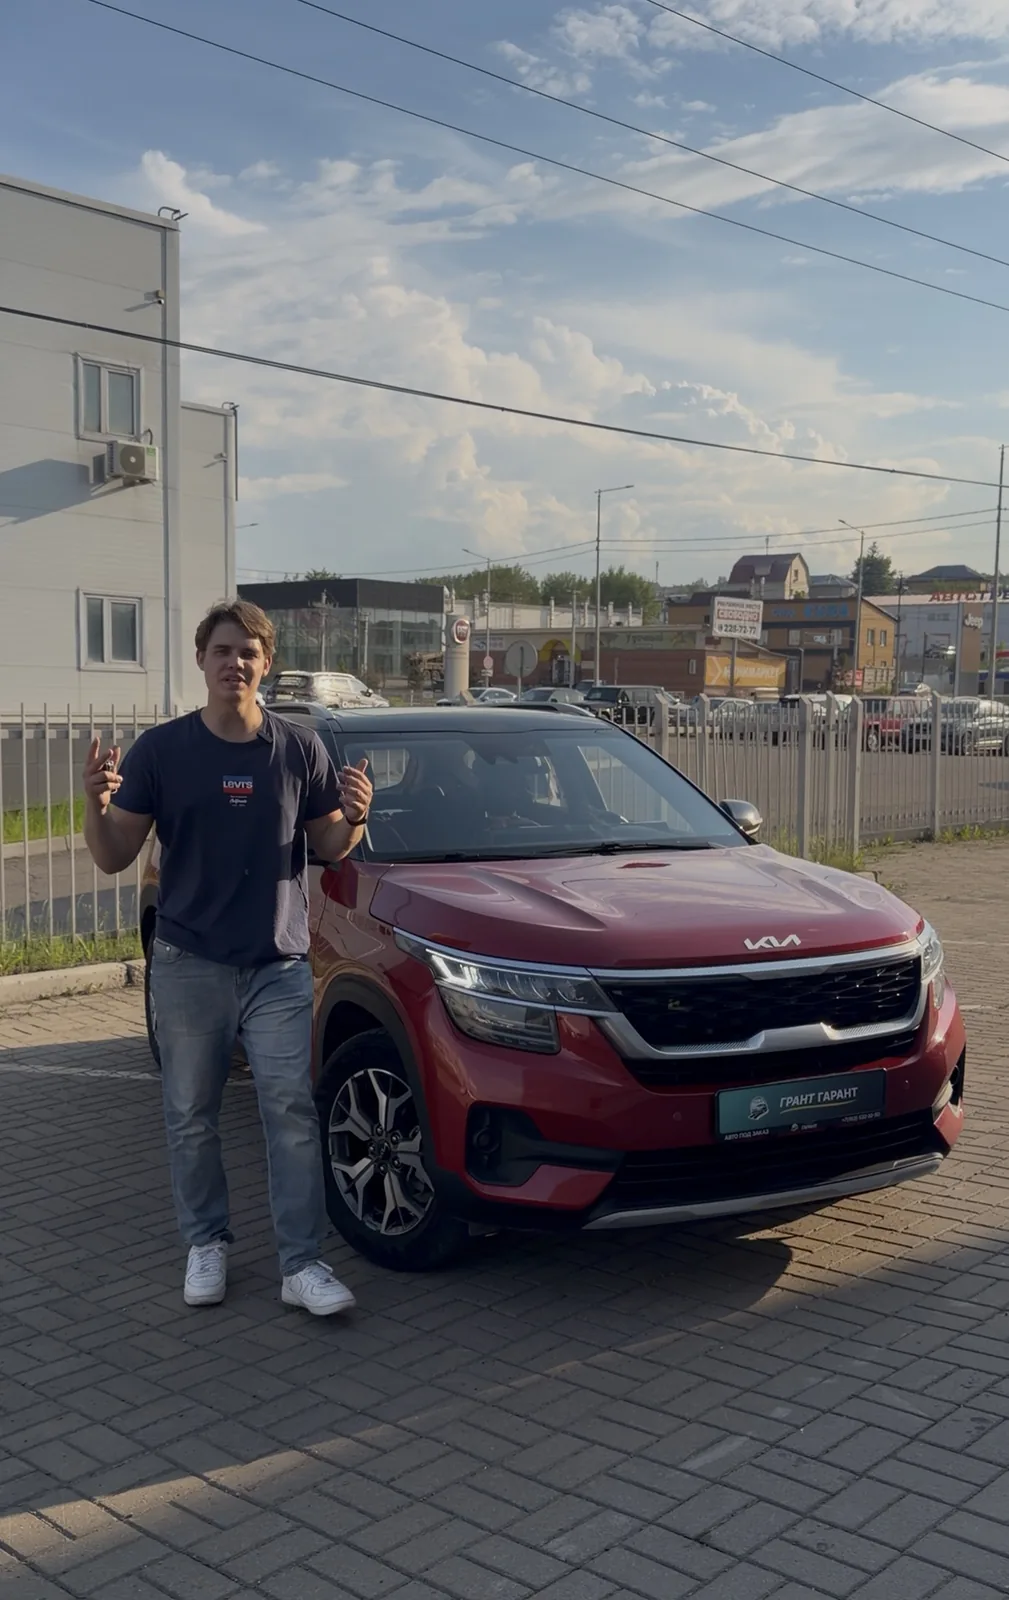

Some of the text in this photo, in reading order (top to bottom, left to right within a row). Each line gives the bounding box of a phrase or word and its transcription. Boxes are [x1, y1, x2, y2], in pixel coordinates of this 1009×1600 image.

[963, 612, 984, 629] Jeep
[743, 934, 802, 950] KIA
[779, 1087, 859, 1108] ГРАНТ ГАРАНТ
[724, 1133, 739, 1141] АВТО
[752, 1128, 770, 1137] ЗАКАЗ
